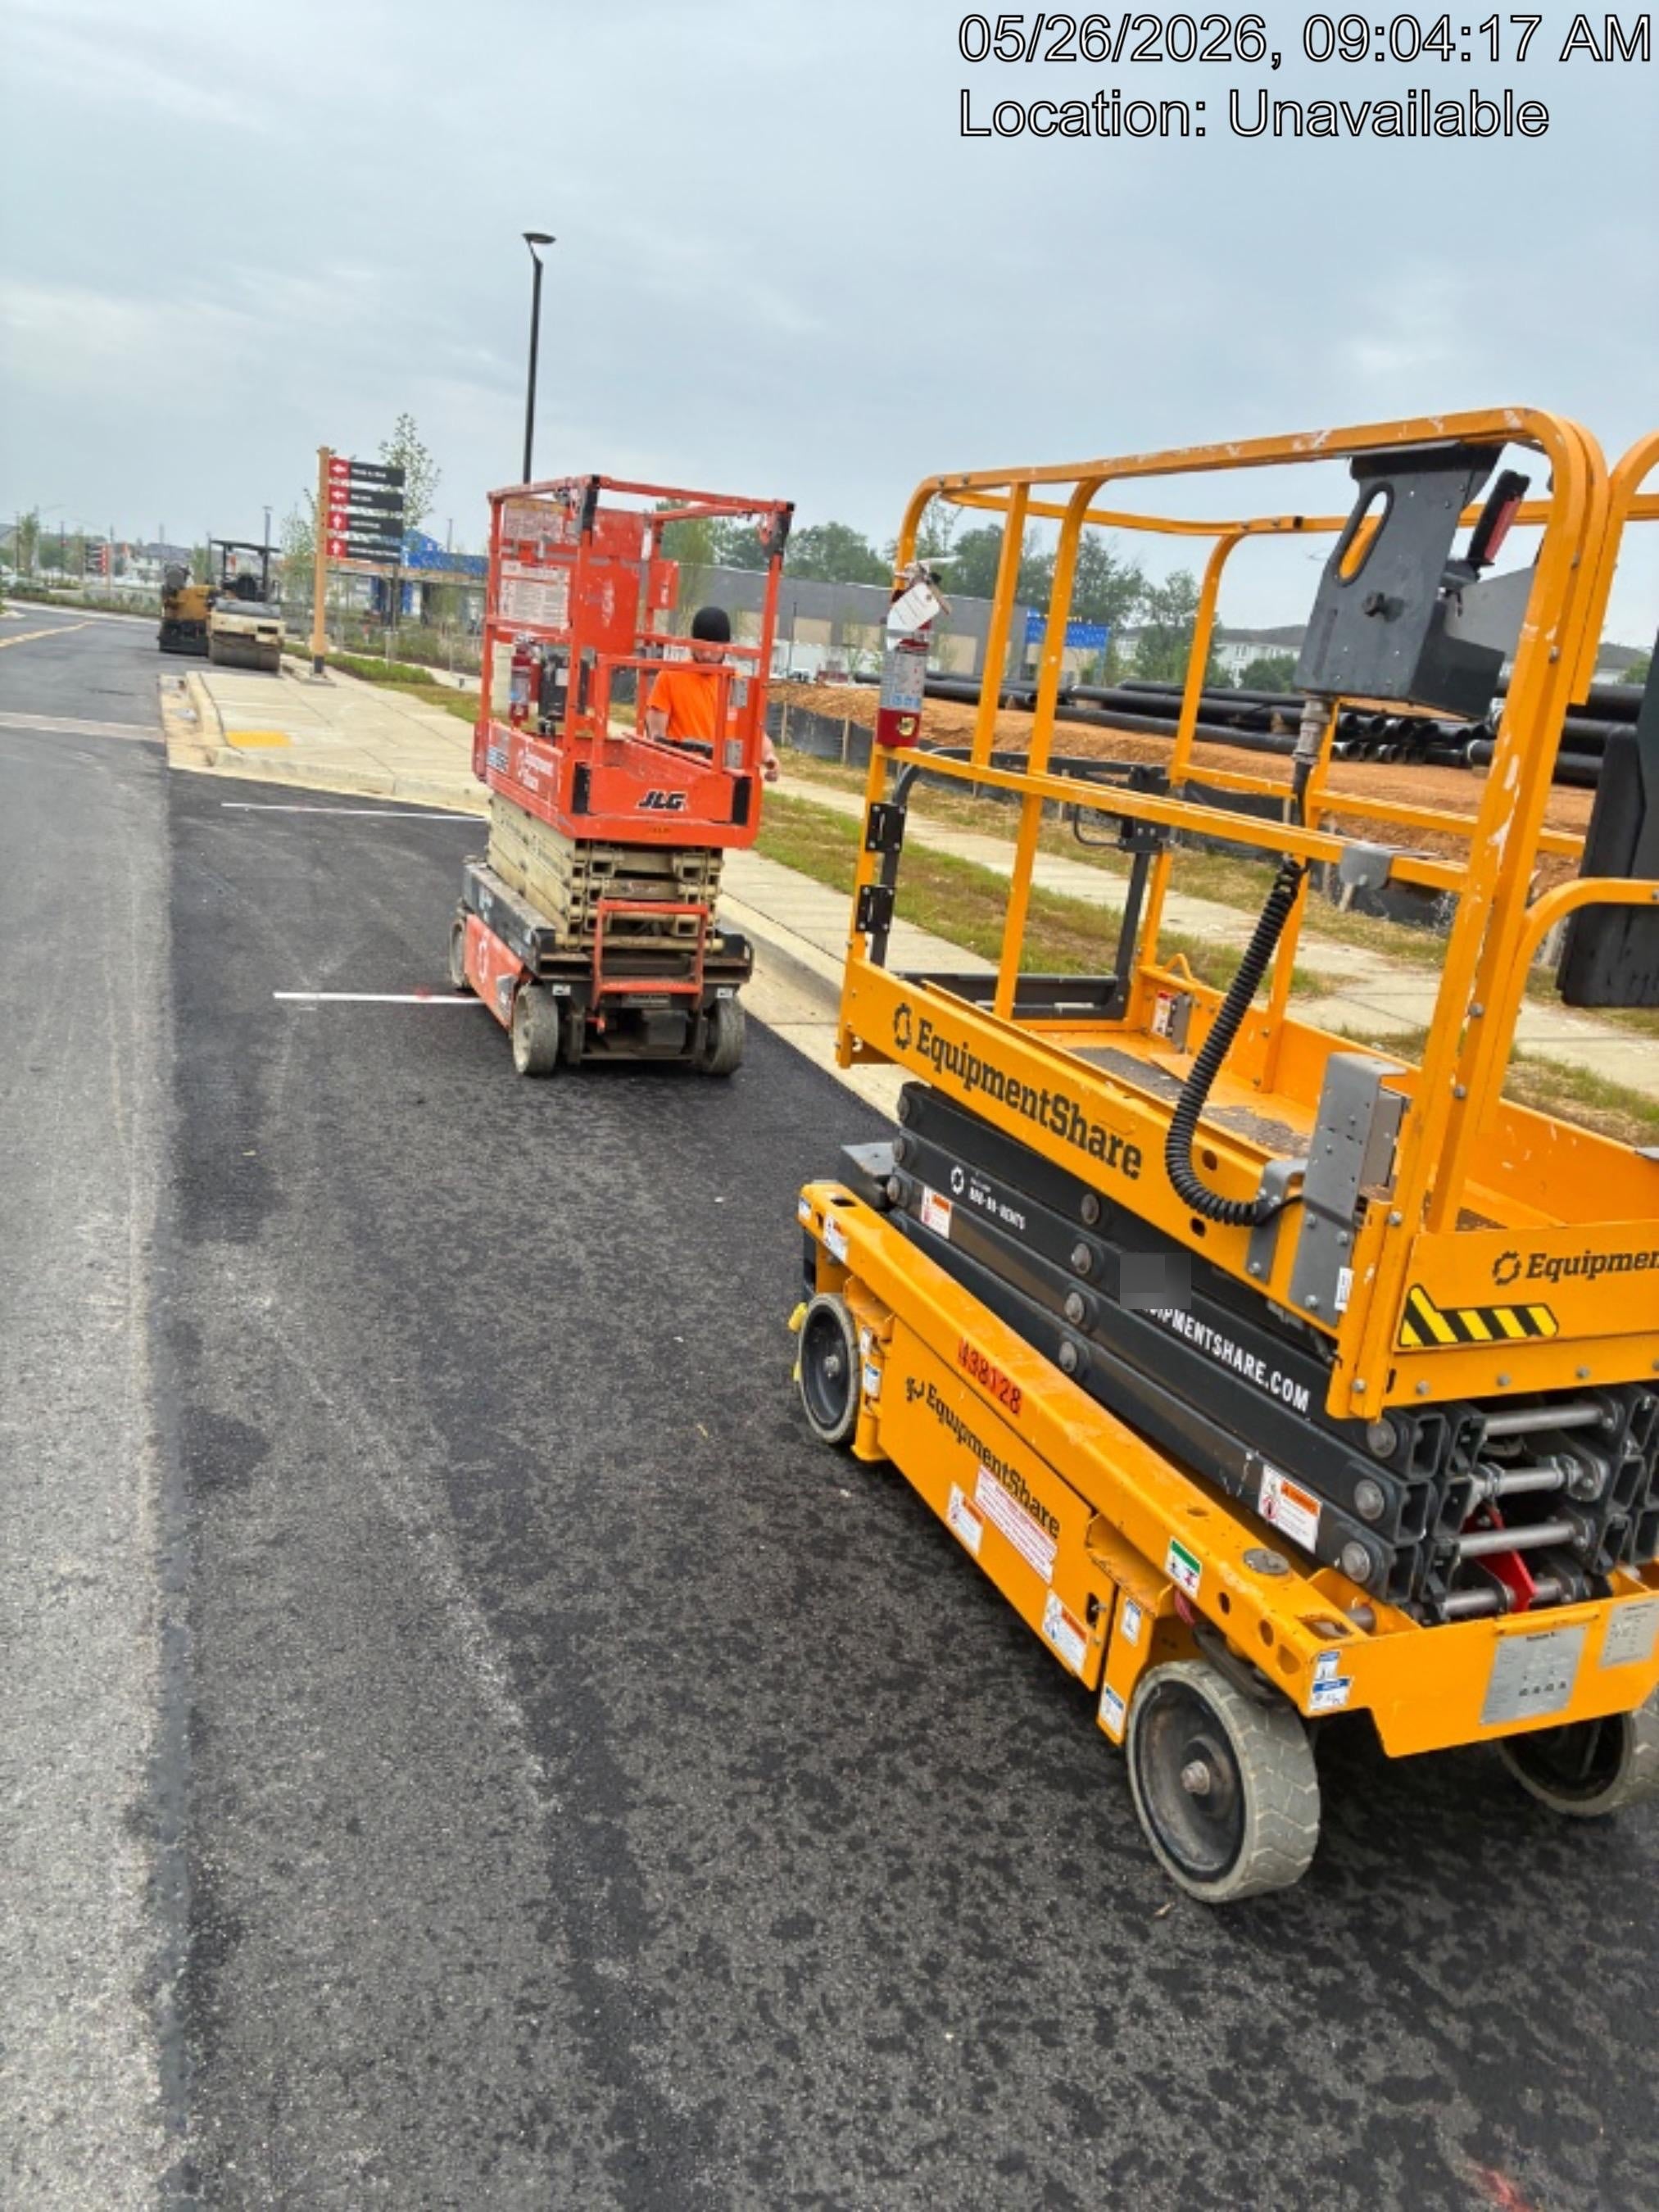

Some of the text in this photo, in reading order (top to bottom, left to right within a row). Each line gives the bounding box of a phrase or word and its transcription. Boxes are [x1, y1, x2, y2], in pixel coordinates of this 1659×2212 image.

[637, 790, 687, 810] JLG
[916, 1018, 1142, 1181] EquipmentShare
[1145, 1308, 1309, 1412] PMENTSHARE.COM
[927, 1383, 1060, 1539] EquipmentShare
